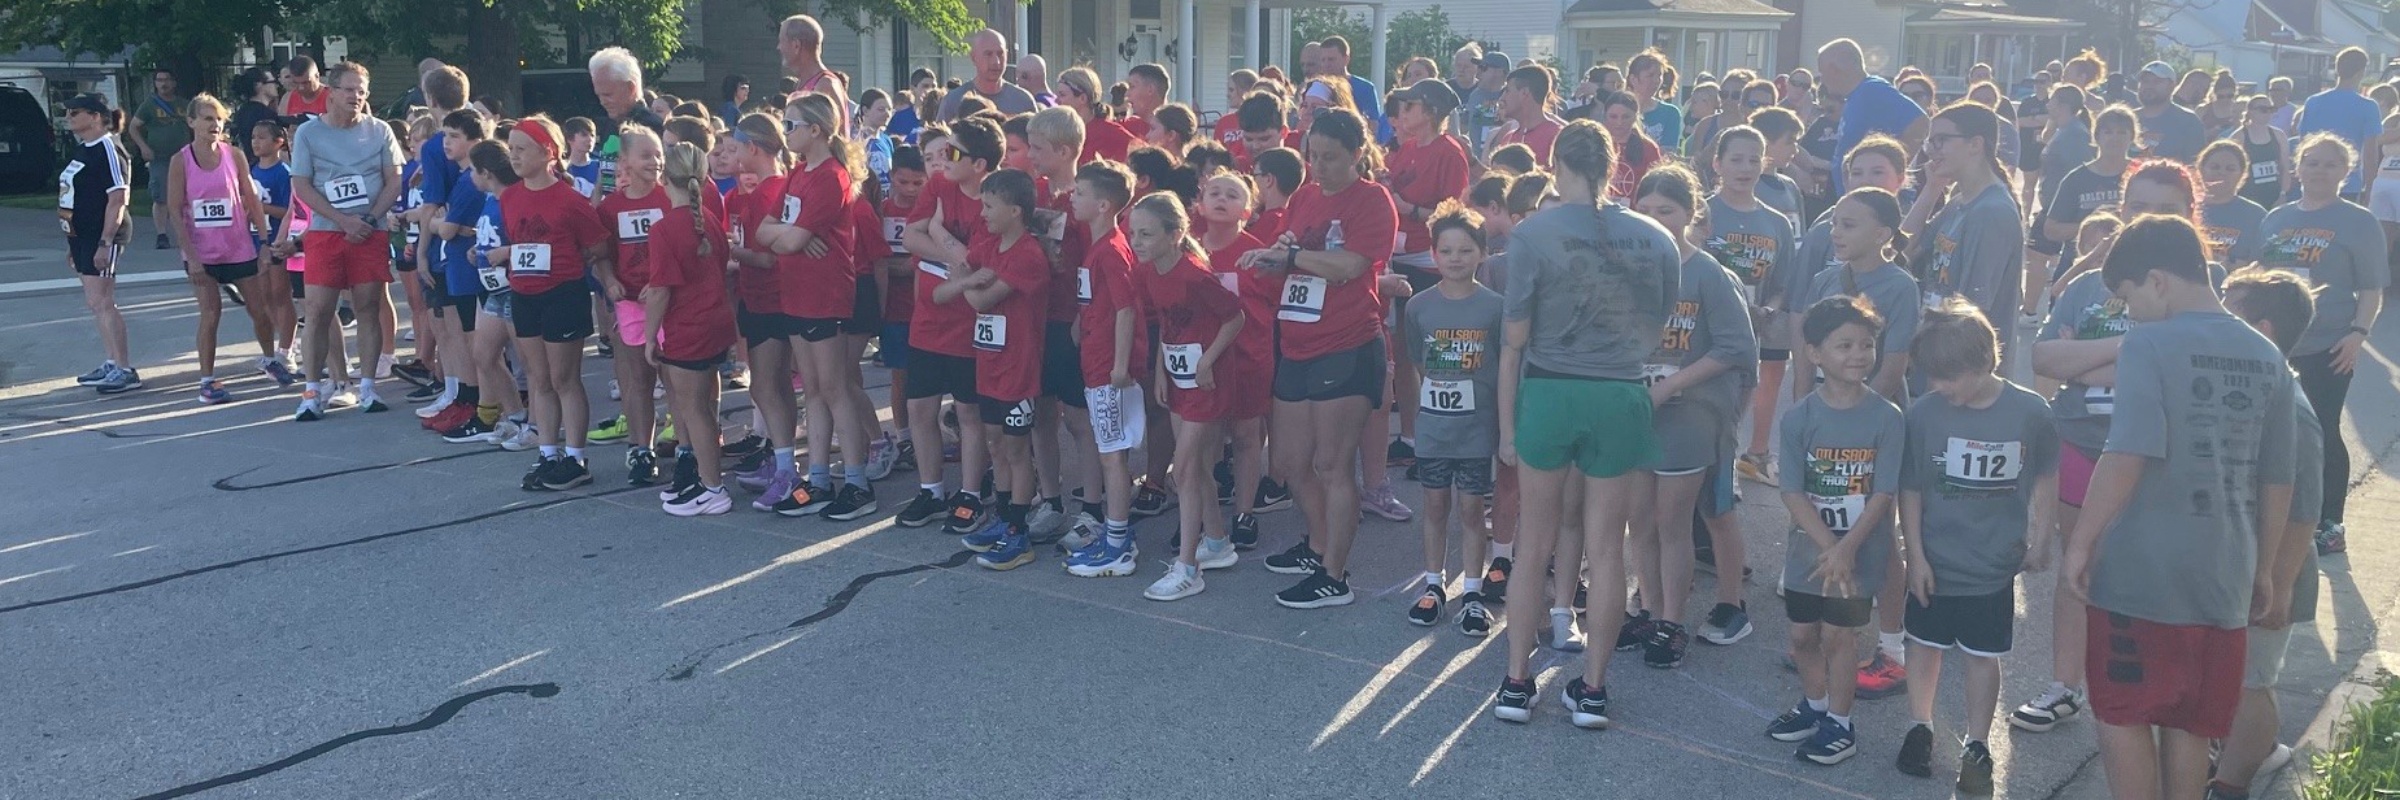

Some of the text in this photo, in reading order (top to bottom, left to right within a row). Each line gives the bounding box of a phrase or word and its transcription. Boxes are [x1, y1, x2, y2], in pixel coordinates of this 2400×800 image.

[333, 182, 359, 198] 173
[202, 204, 226, 217] 138
[894, 225, 904, 240] 2
[1726, 232, 1777, 252] DILLSBOR
[517, 251, 536, 268] 42
[1288, 284, 1309, 305] 38
[977, 323, 994, 342] 25
[1662, 327, 1692, 352] 5K
[1169, 355, 1188, 373] 34
[1461, 351, 1484, 370] 5K
[1428, 390, 1463, 410] 102
[1814, 447, 1877, 462] DILLSBOR
[1961, 452, 2007, 478] 112
[1820, 506, 1849, 528] 01
